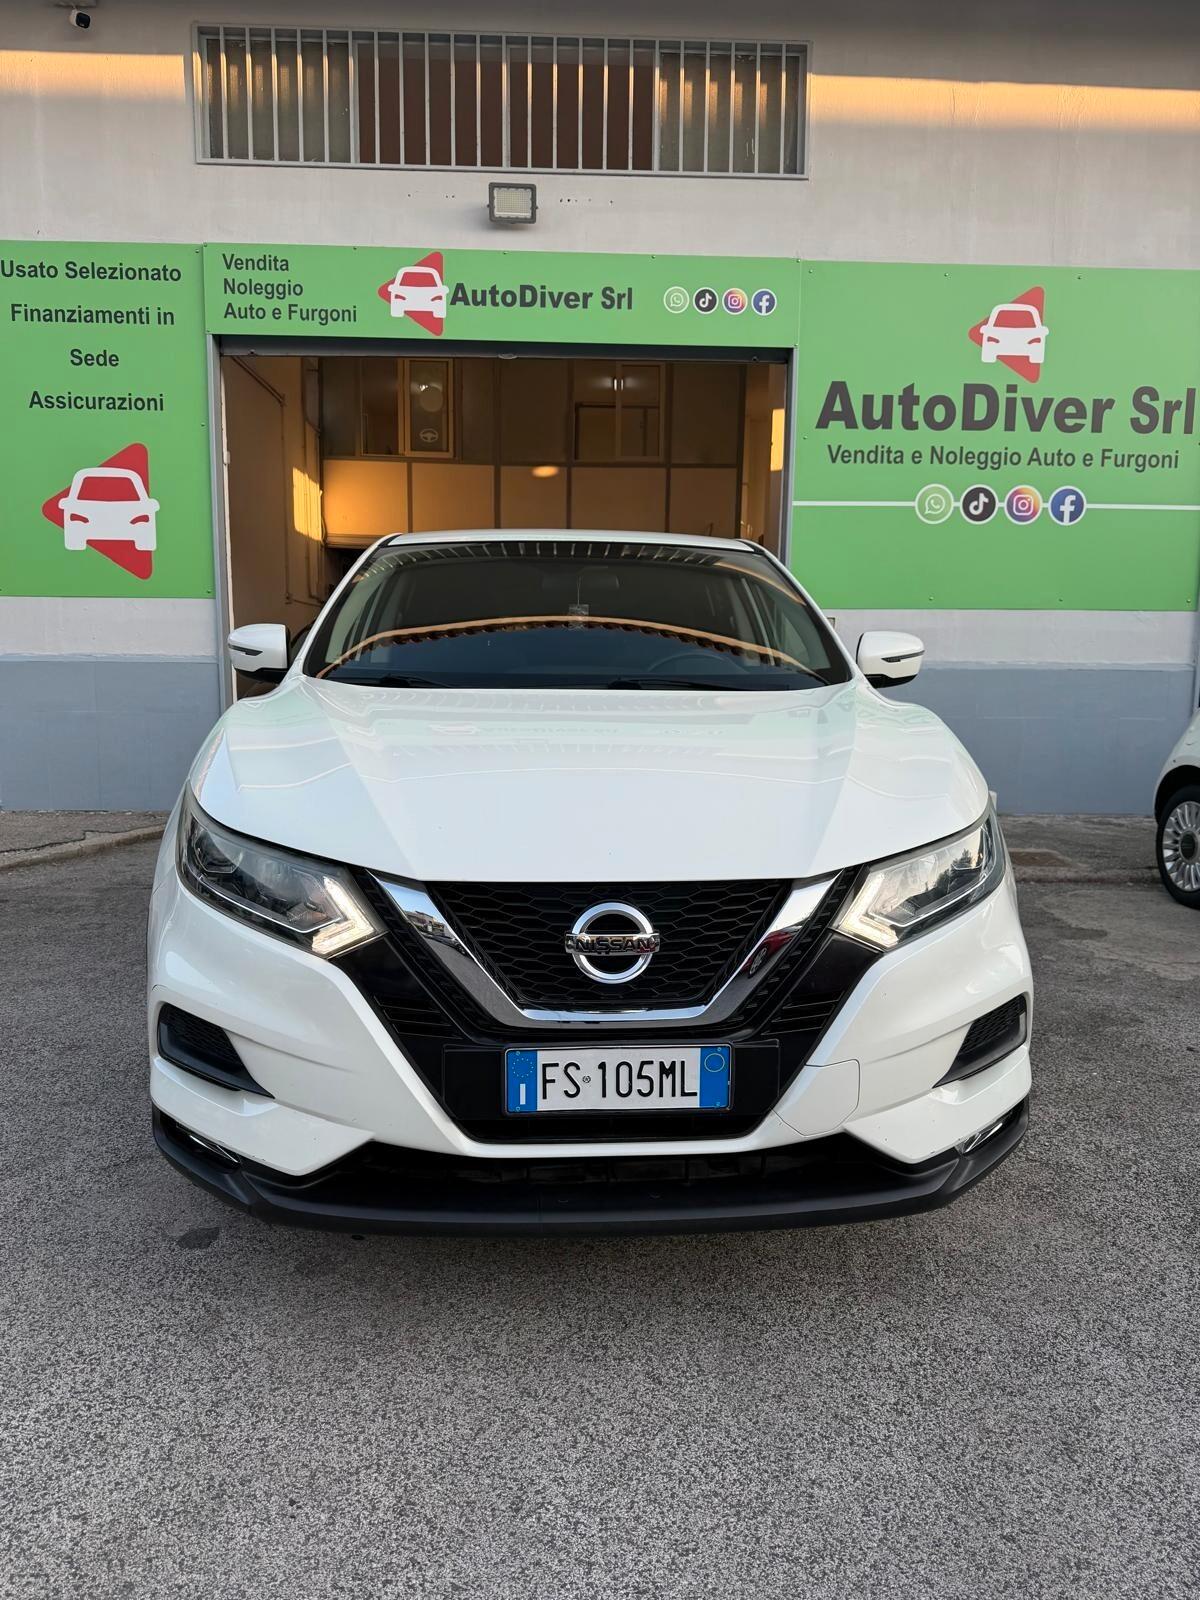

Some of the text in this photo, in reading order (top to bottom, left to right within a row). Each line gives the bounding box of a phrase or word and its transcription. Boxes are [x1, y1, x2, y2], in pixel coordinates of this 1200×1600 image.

[0, 259, 182, 282] Usato Selezionato
[221, 253, 289, 272] Vendita
[223, 277, 304, 301] Noleggio
[449, 282, 633, 311] AutoDiver Srl
[10, 303, 175, 326] Finanziamenti in
[223, 302, 357, 326] Auto e Furgoni
[70, 348, 120, 367] Sede
[28, 390, 164, 412] Assicurazioni
[815, 380, 1196, 435] AutoDiver Srl
[827, 444, 1180, 473] Vendita e Noleggio Auto e Furgoni
[576, 937, 655, 952] NISSAN
[541, 1060, 698, 1100] FS 105ML
